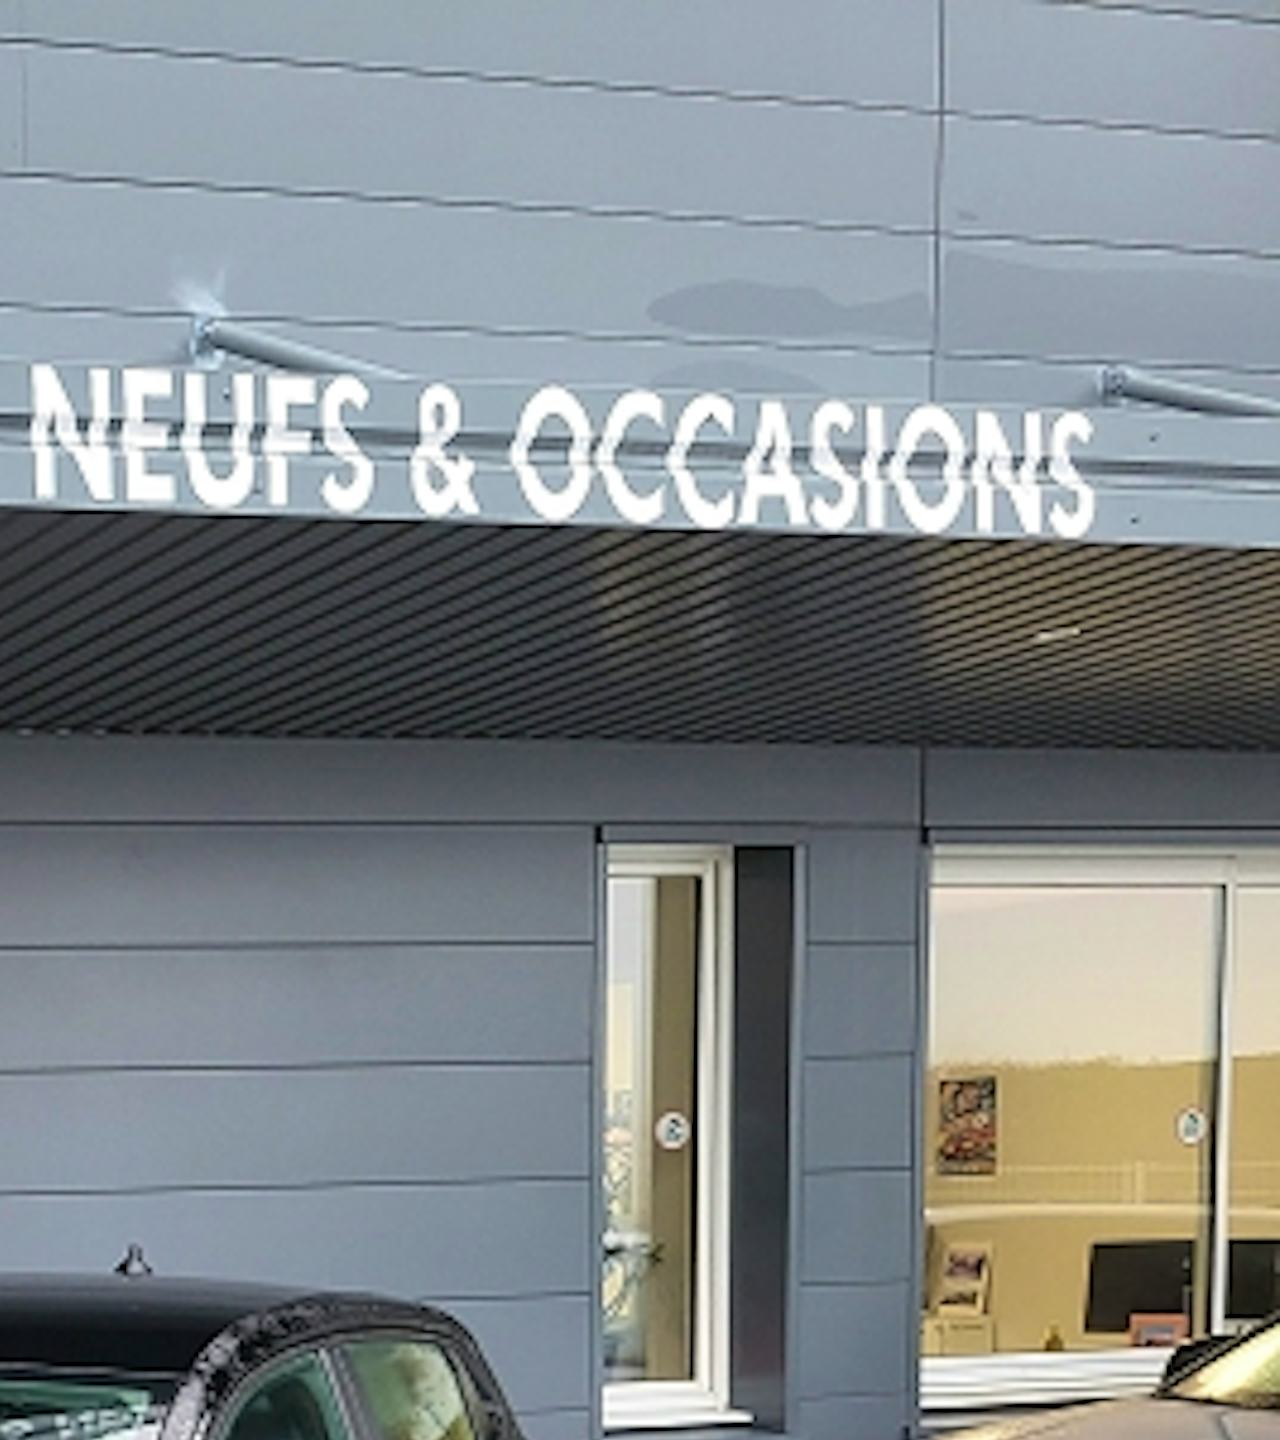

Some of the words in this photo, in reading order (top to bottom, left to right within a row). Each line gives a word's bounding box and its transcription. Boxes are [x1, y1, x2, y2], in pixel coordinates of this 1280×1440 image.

[29, 364, 373, 512] NEUFS
[410, 384, 481, 518] &
[511, 384, 1096, 538] OCCASIONS
